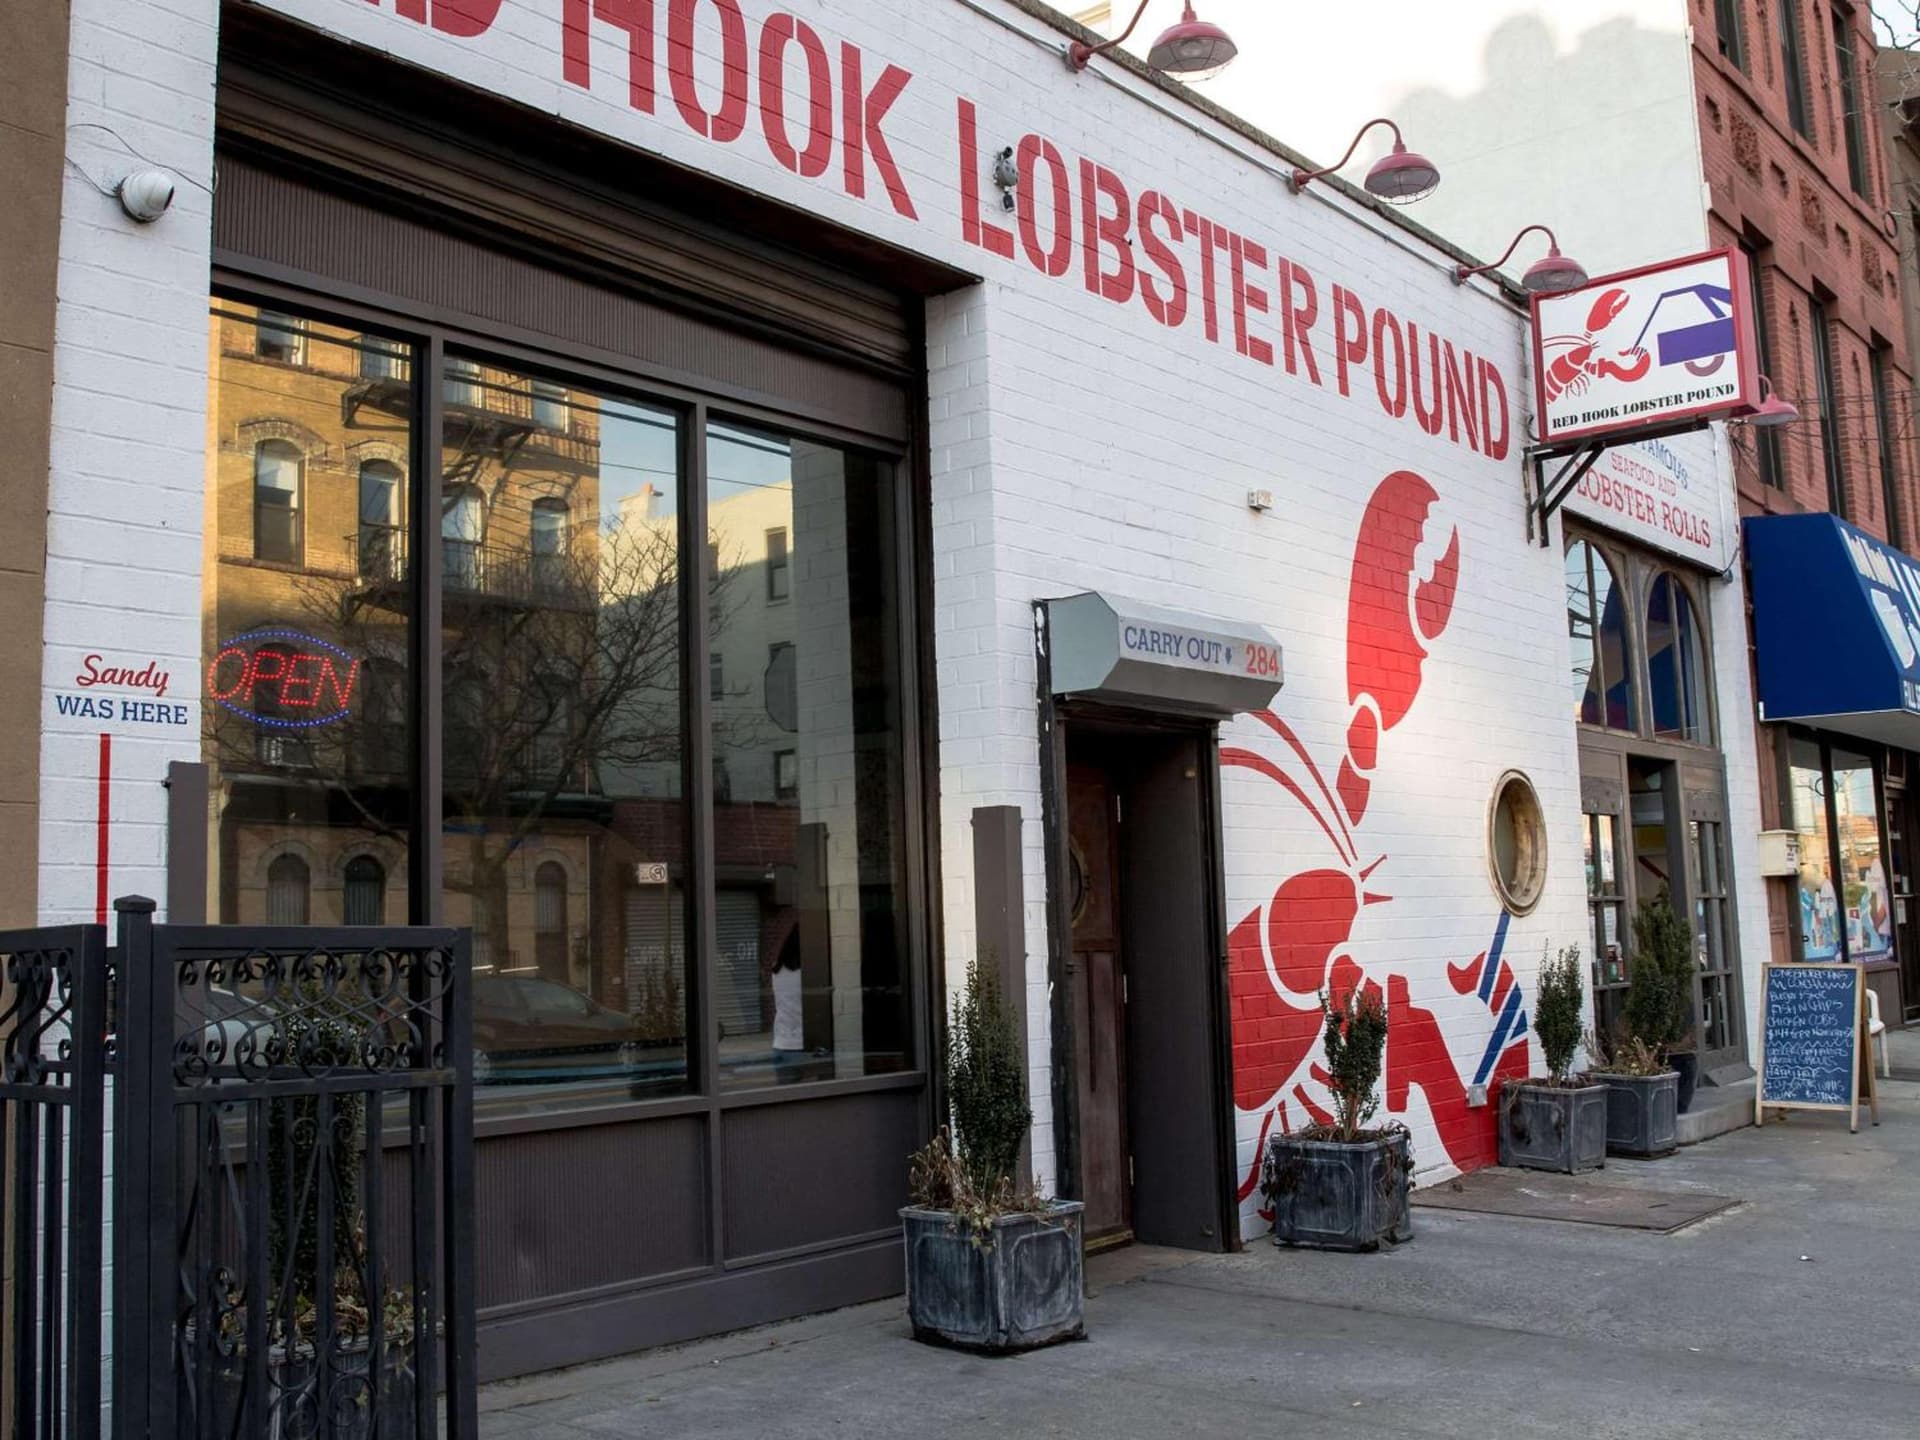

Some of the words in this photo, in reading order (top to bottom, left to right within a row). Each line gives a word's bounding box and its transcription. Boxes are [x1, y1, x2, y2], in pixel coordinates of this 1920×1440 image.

[562, 0, 919, 222] HOOK
[957, 96, 1322, 386] LOBSTER
[1332, 283, 1511, 461] POUND
[1552, 415, 1578, 429] RED
[1582, 406, 1619, 422] HOOK
[1623, 393, 1683, 414] LOBSTER
[1687, 383, 1735, 402] POUND
[1661, 500, 1712, 549] ROLLS
[76, 654, 170, 697] Sandy
[1124, 626, 1183, 657] CARRY
[1187, 637, 1222, 664] OUT
[1246, 643, 1278, 676] 284
[207, 647, 359, 708] OPEN
[55, 695, 114, 720] WAS
[121, 700, 188, 725] HERE
